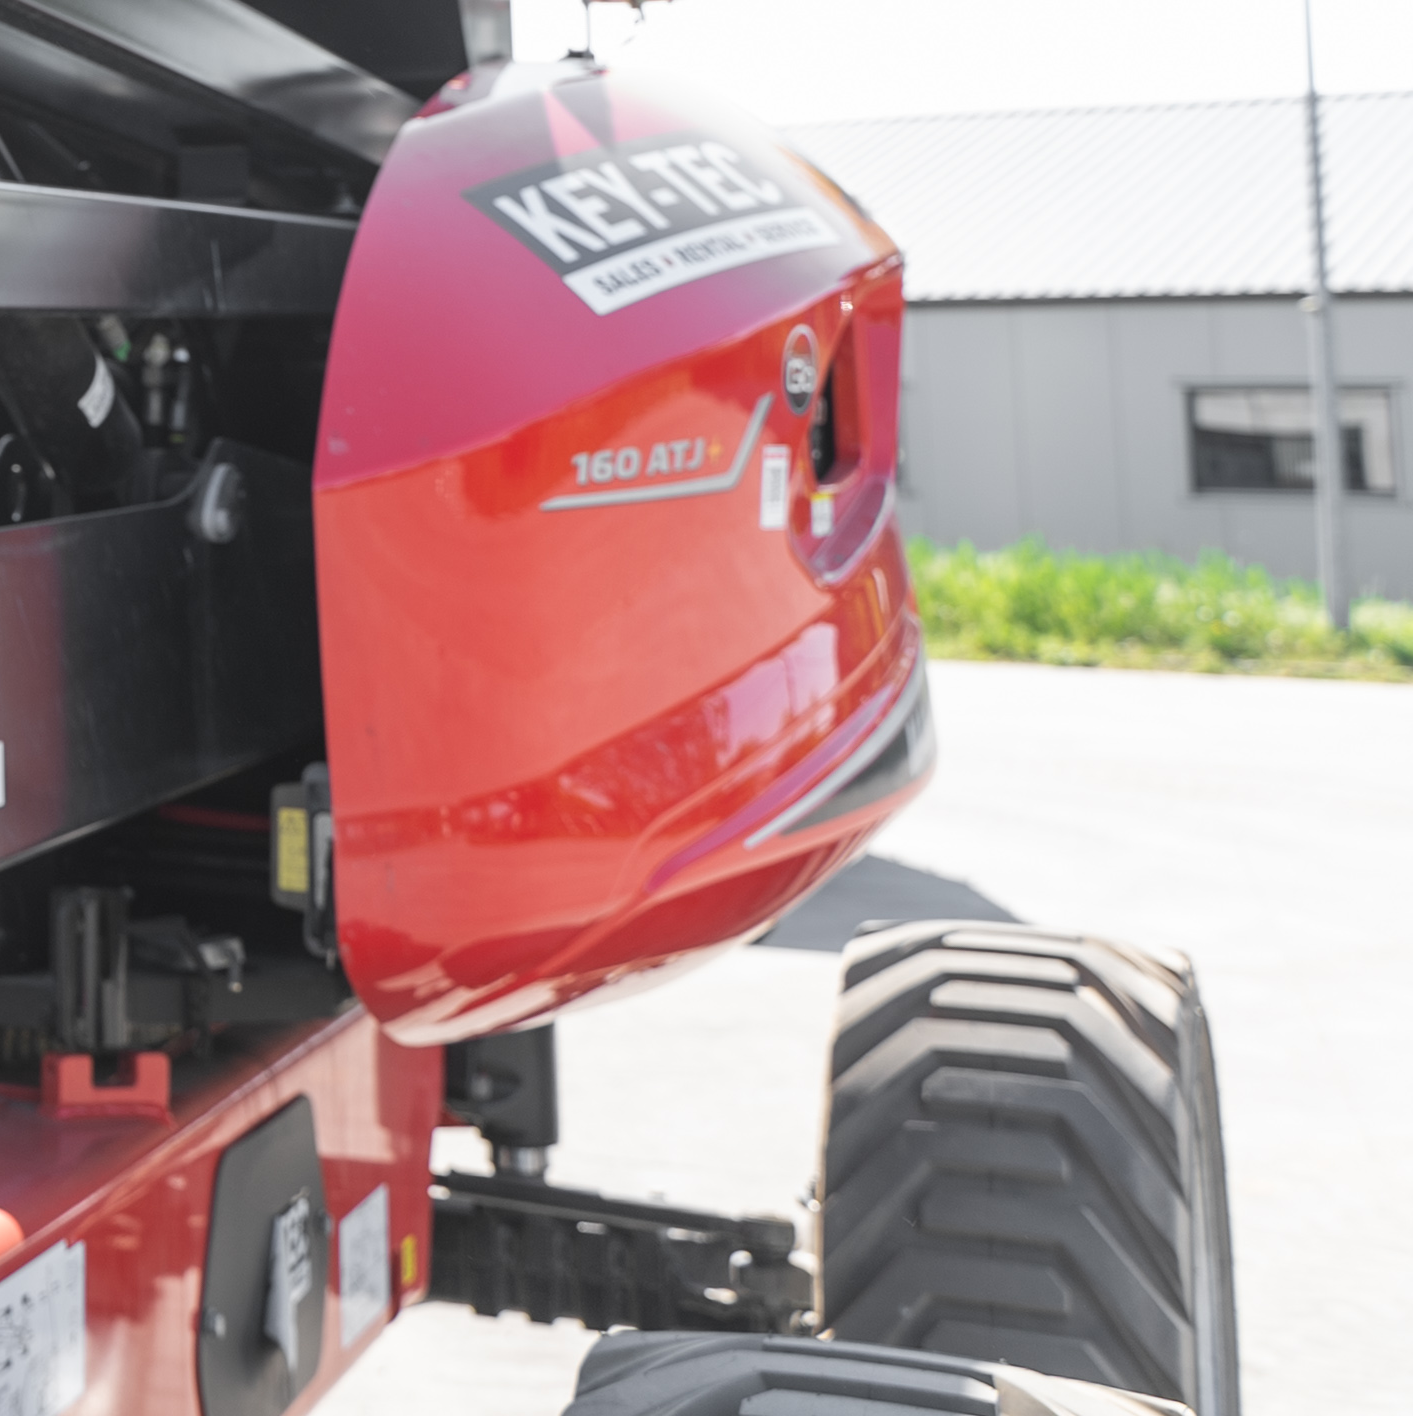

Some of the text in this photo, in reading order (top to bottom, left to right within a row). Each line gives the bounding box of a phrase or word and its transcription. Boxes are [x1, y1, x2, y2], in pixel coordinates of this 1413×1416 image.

[492, 141, 785, 264] KEY-TEC
[592, 258, 661, 296] SALES
[673, 232, 746, 267] RENTAL
[571, 447, 641, 485] 160
